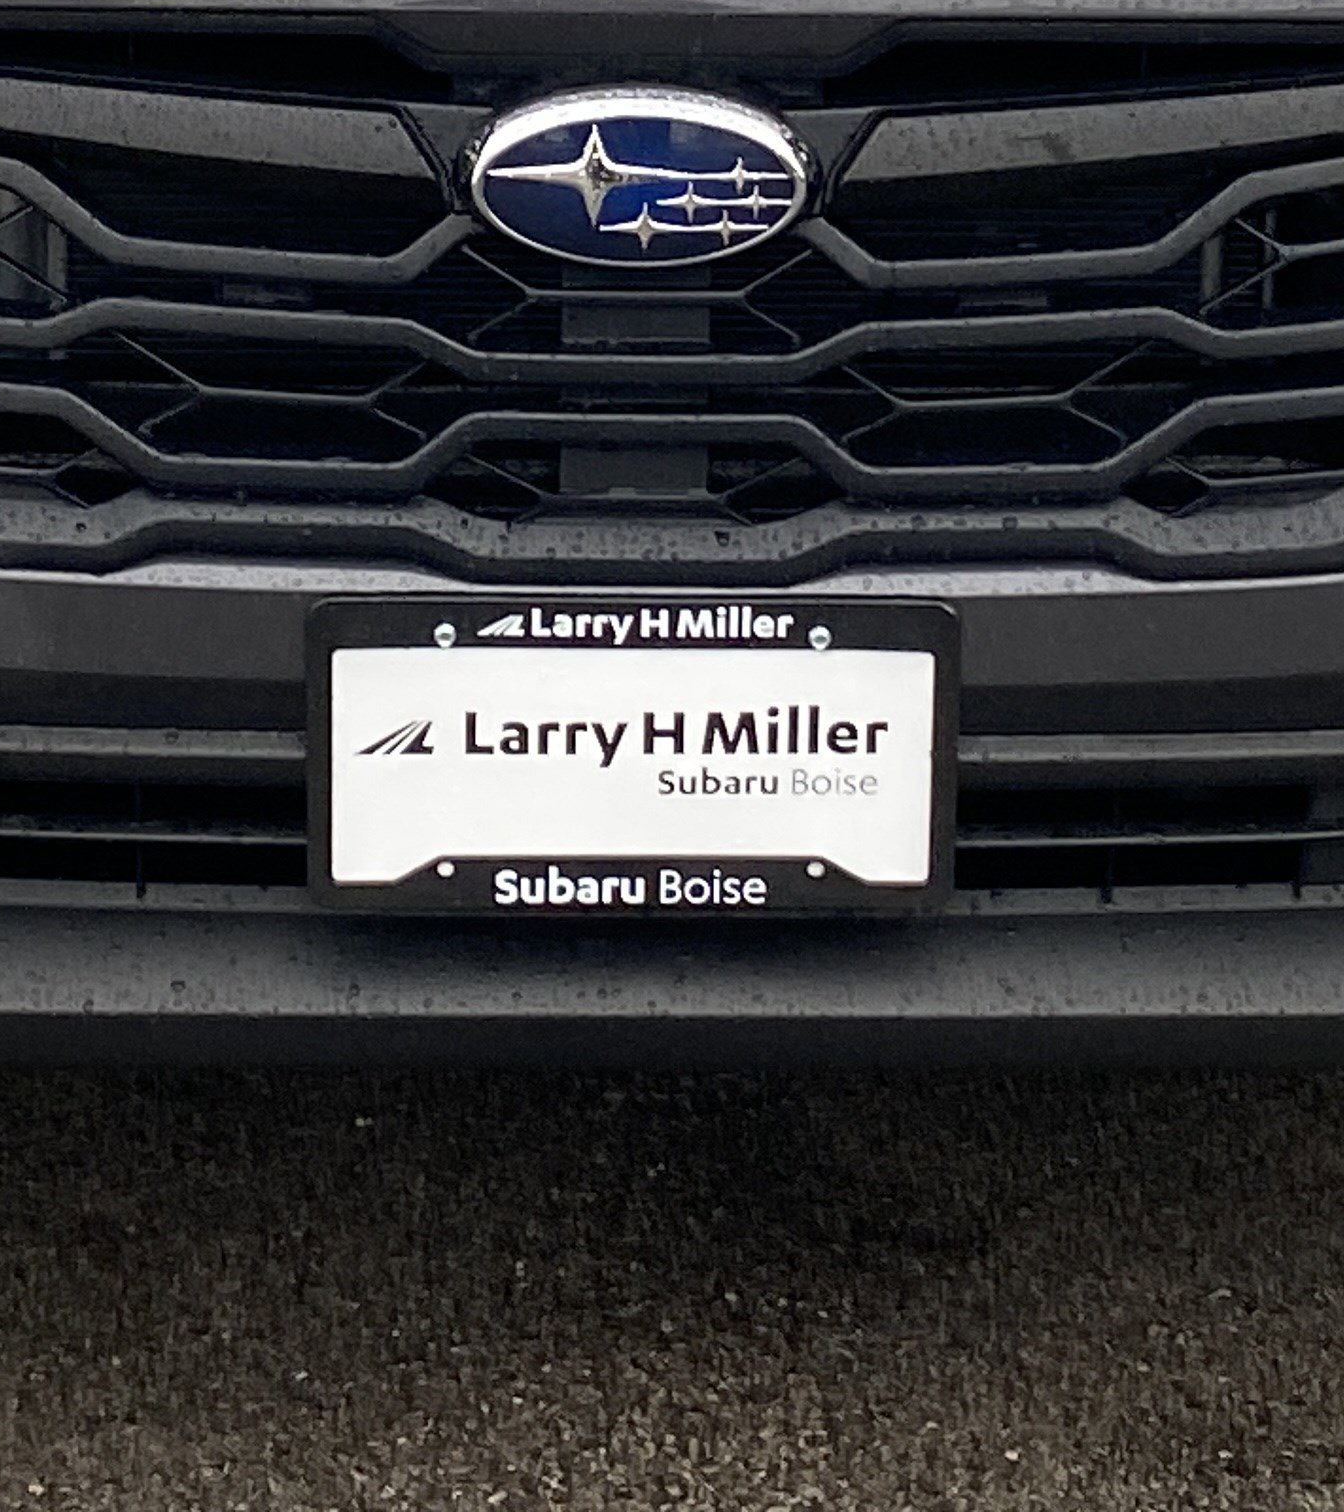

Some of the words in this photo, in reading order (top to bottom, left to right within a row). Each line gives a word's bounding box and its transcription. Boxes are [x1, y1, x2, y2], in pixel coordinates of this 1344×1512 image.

[531, 606, 635, 646] Larry
[640, 608, 669, 638] H
[676, 605, 794, 638] Miller
[465, 711, 628, 768] Larry
[643, 712, 685, 755] H
[701, 705, 889, 755] Miller
[657, 766, 779, 796] Subaru
[791, 767, 879, 796] Boise
[495, 865, 646, 904] Subaru
[659, 868, 767, 905] Boise
